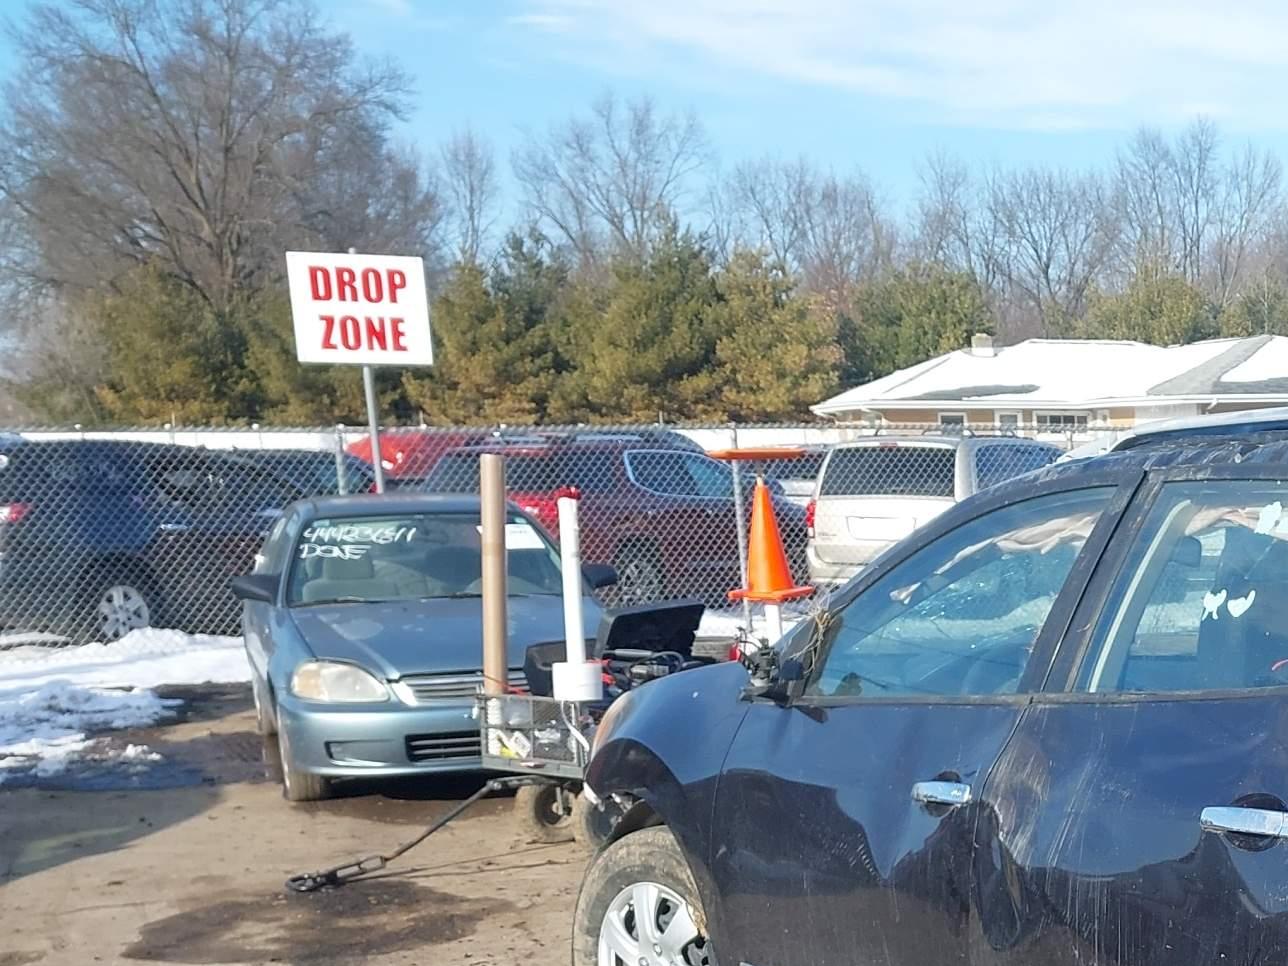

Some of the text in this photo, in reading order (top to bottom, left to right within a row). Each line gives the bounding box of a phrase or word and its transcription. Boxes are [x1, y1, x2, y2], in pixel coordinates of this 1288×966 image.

[308, 265, 407, 303] DROP
[319, 315, 408, 351] ZONE
[300, 543, 372, 560] DONE
